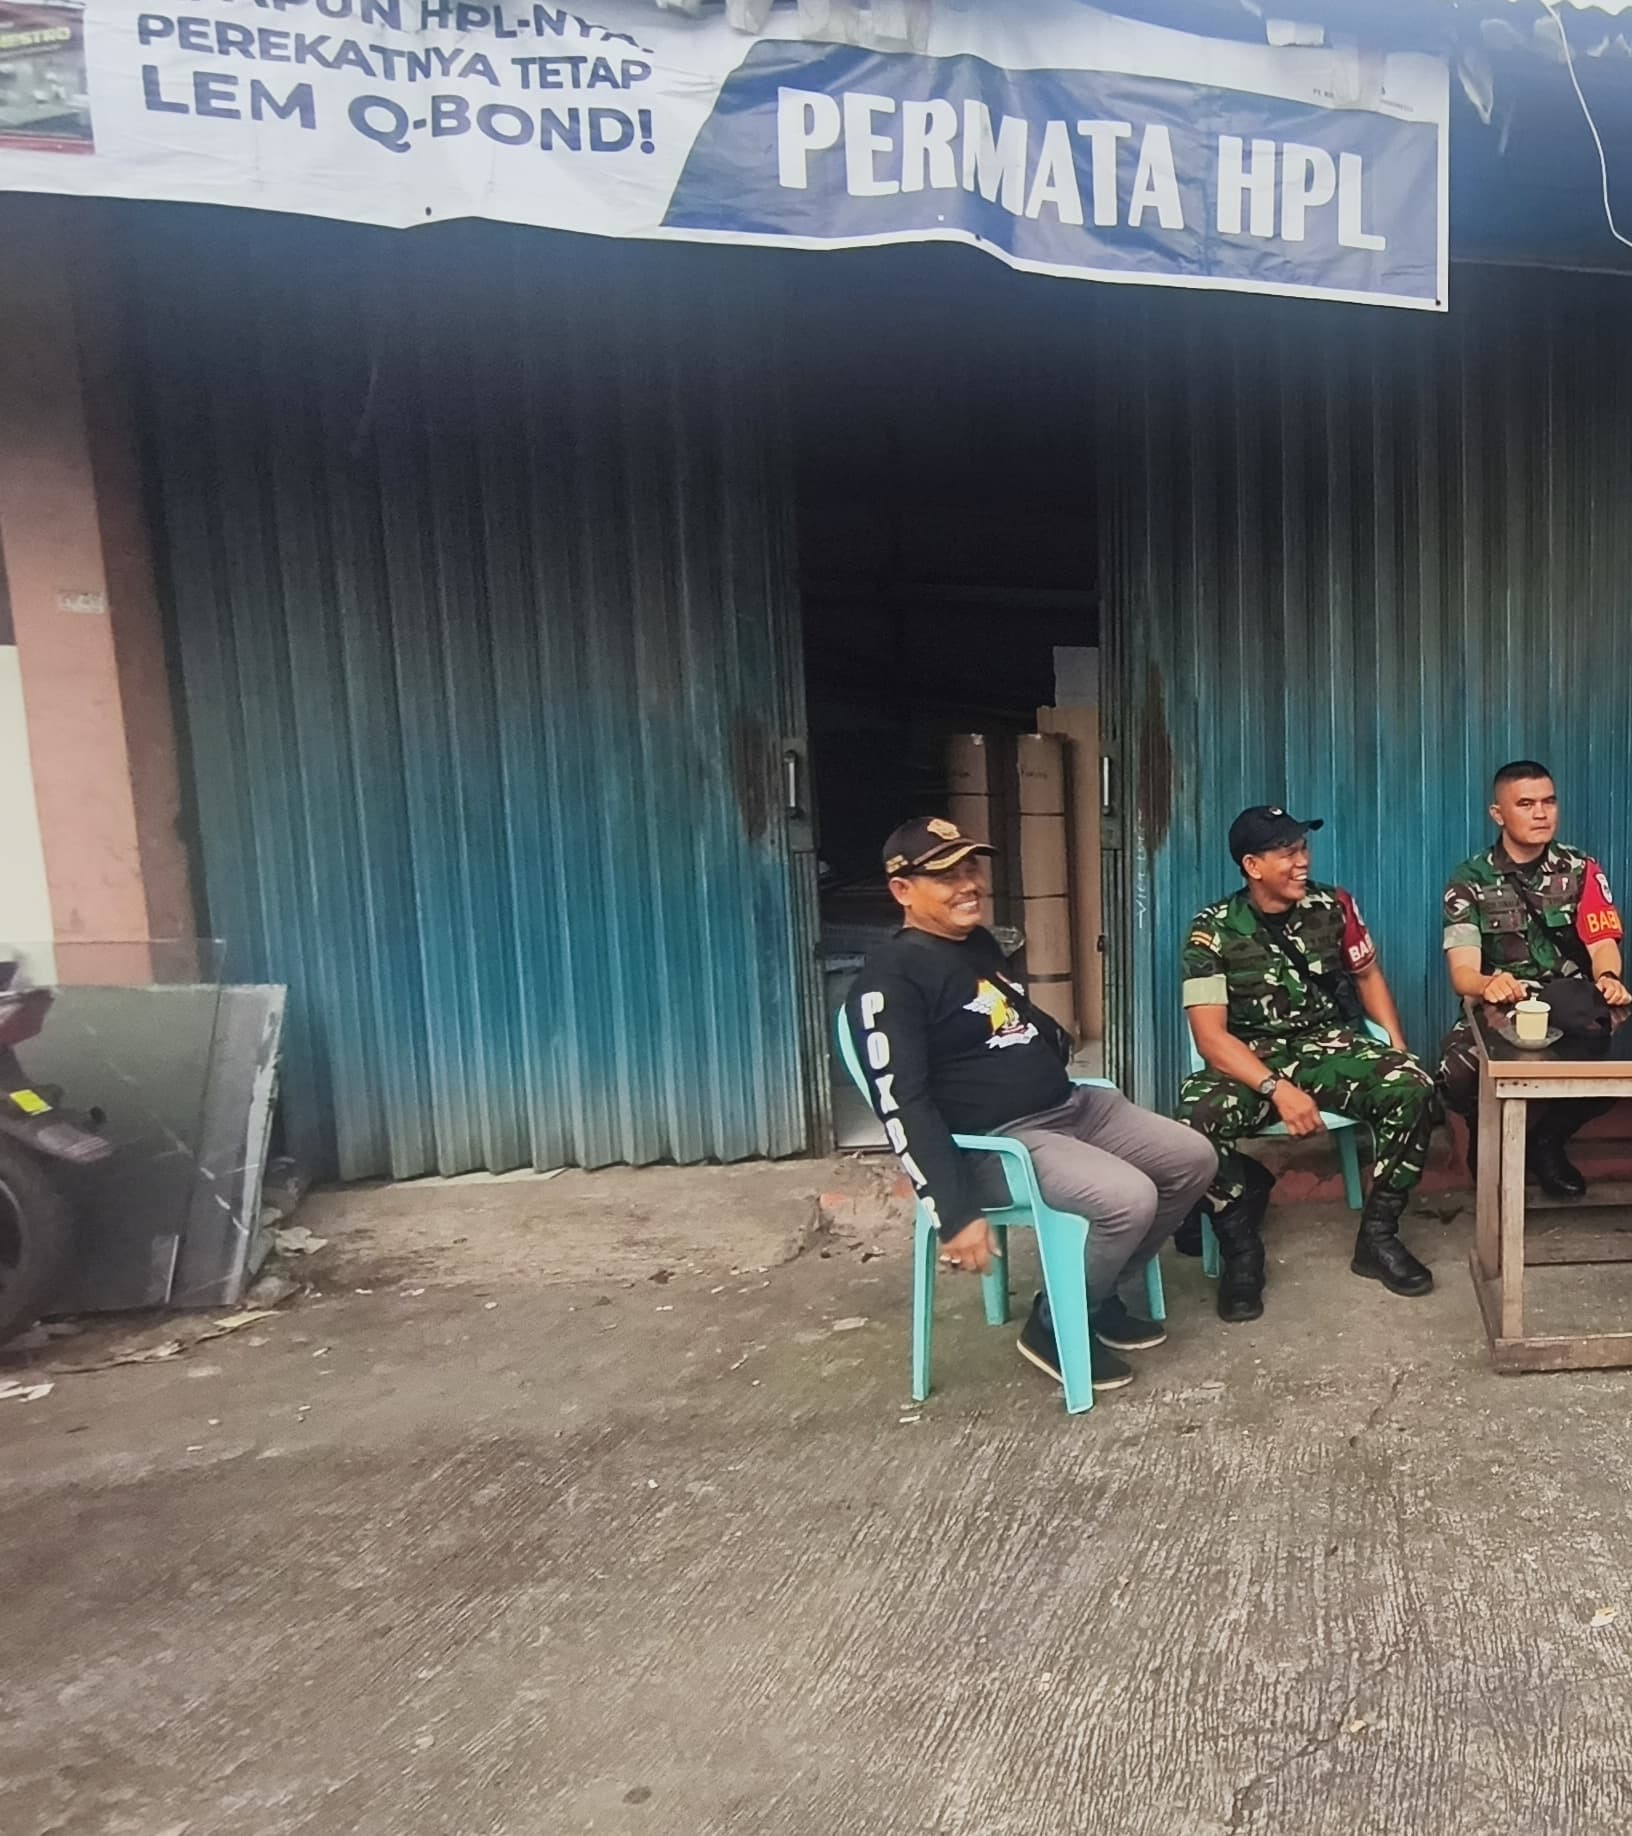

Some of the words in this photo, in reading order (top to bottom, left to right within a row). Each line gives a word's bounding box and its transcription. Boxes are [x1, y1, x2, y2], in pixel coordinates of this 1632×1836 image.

[136, 13, 500, 87] PEREKATNYA
[510, 56, 653, 92] TETAP
[142, 65, 317, 130] LEM
[346, 94, 657, 155] Q-BOND!
[776, 86, 1186, 230] PERMATA
[1216, 135, 1387, 251] HPL
